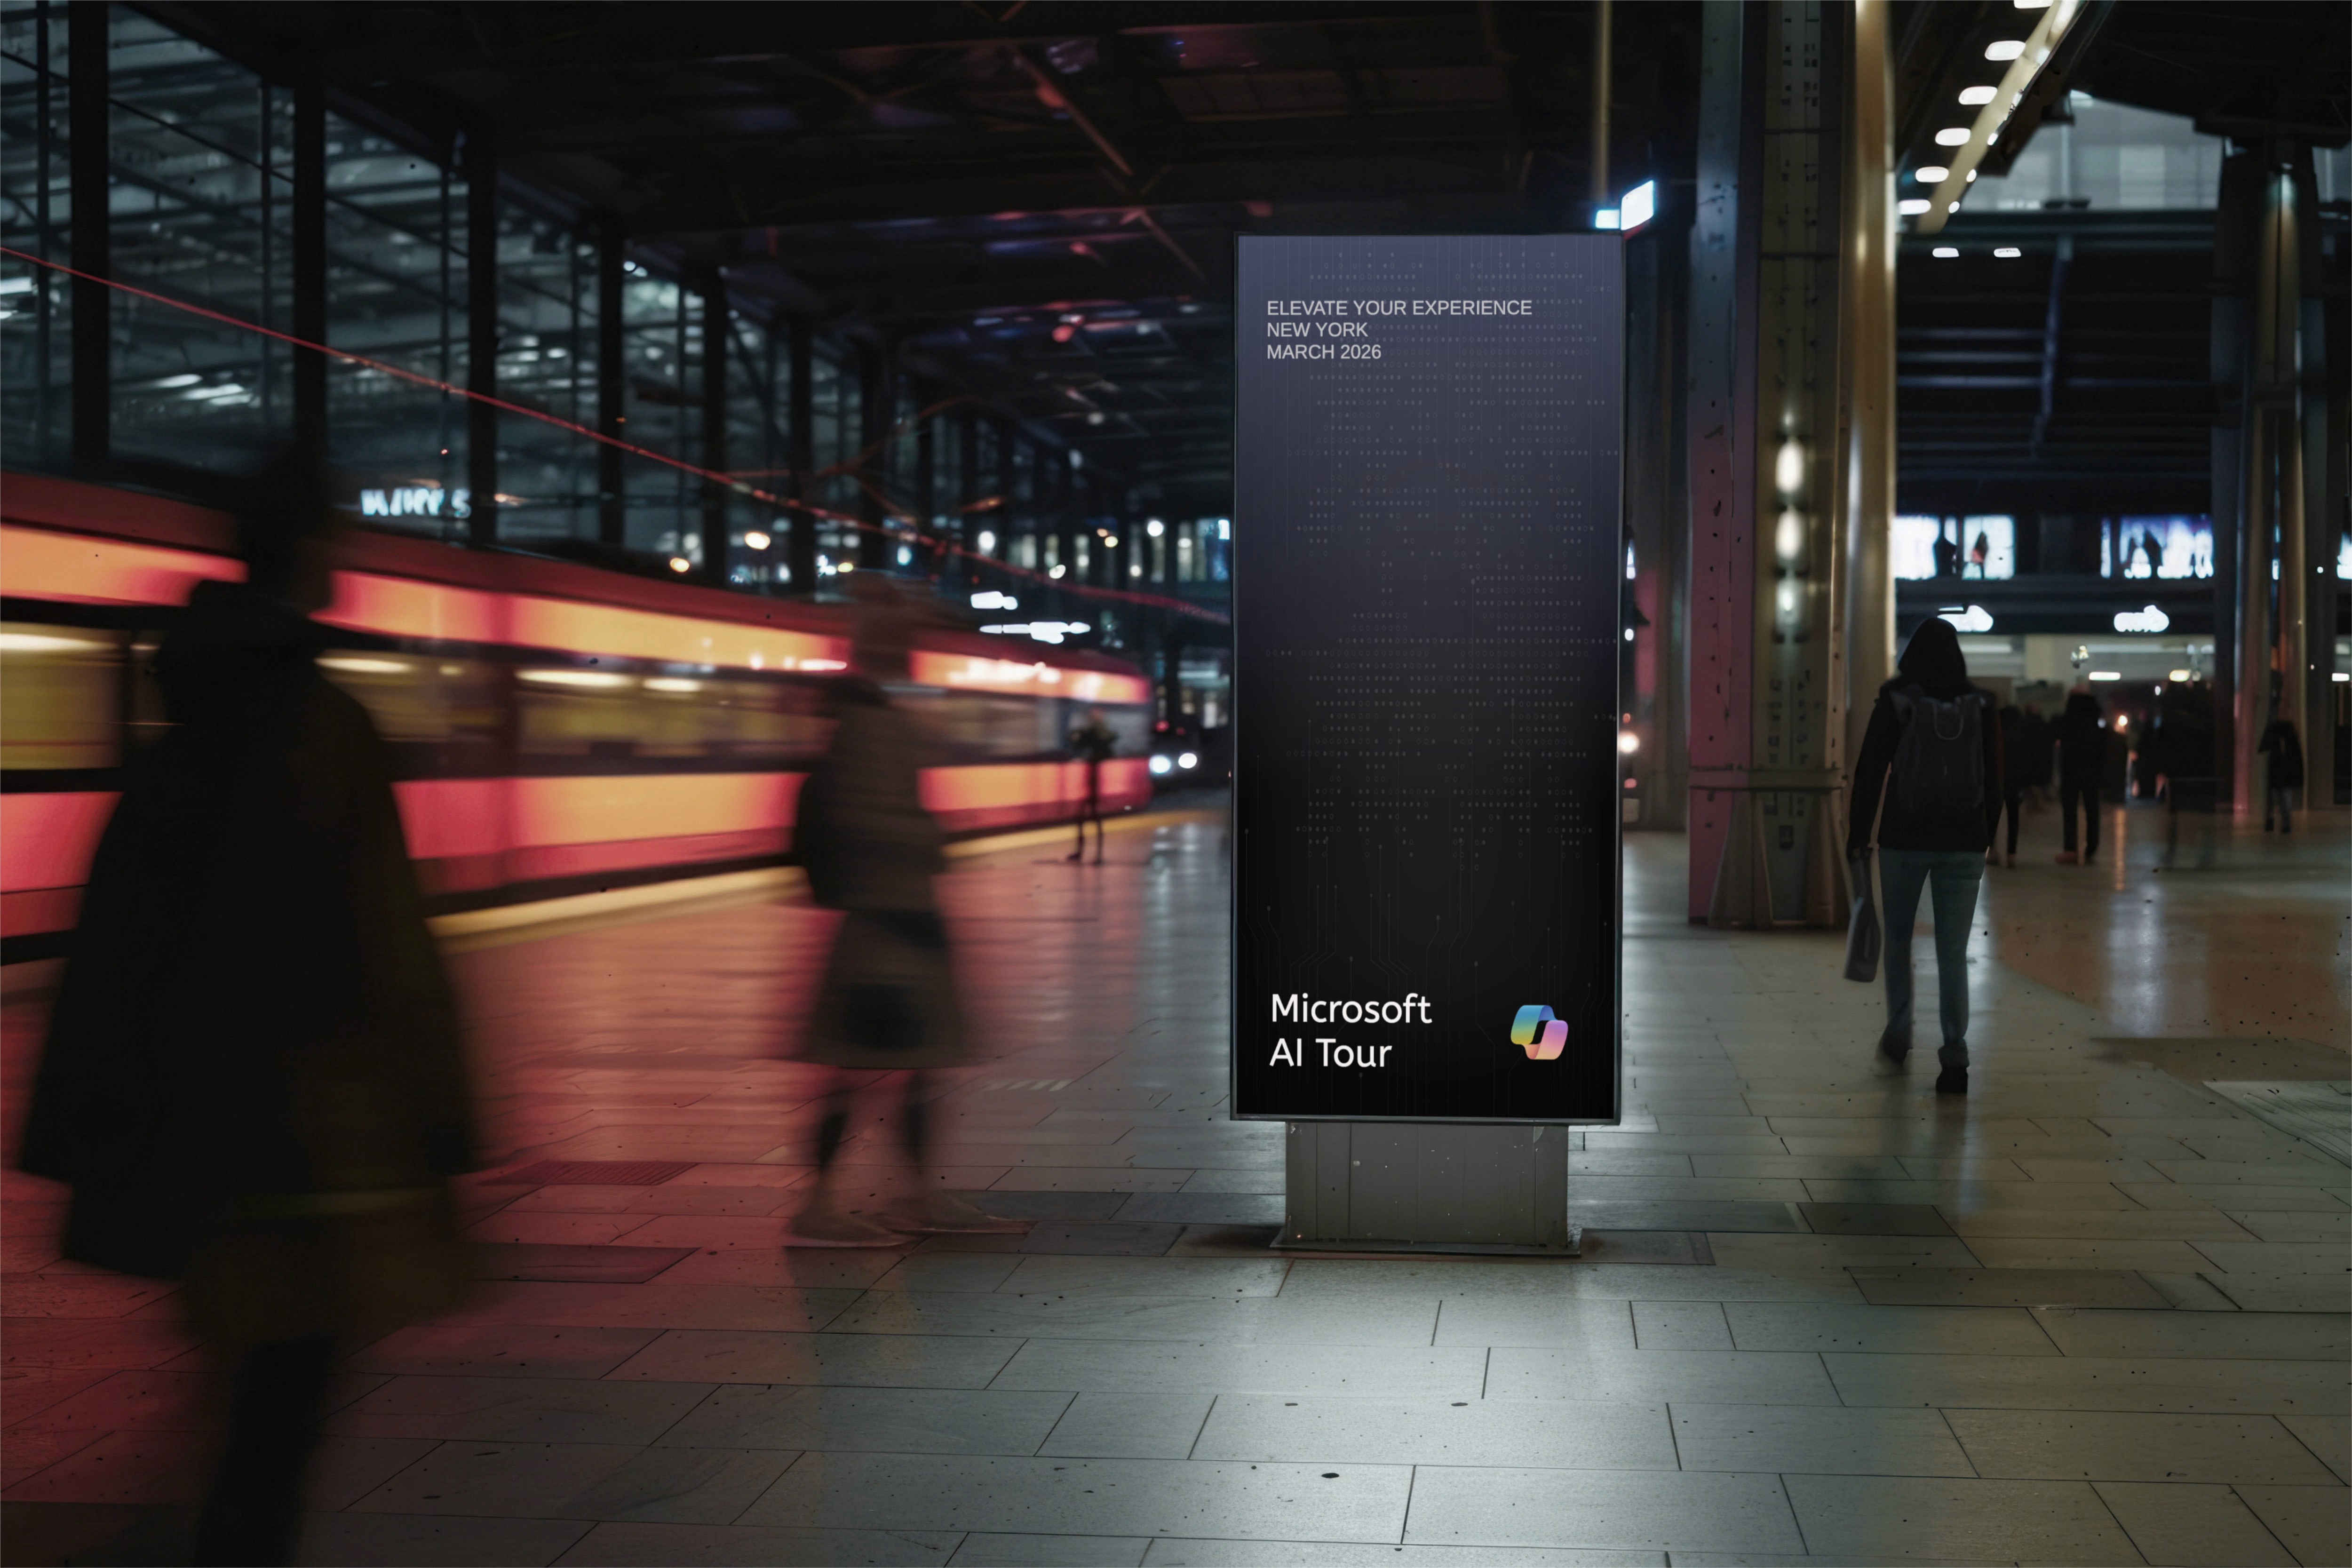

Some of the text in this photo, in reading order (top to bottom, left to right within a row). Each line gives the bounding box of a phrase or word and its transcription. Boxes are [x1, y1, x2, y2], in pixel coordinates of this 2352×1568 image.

[1267, 300, 1533, 316] ELEVATE YOUR EXPERIENCE
[1267, 322, 1368, 337] NEW YORK
[1267, 344, 1382, 359] MARCH 2026
[1271, 993, 1432, 1024] Microsoft
[1269, 1038, 1392, 1067] AI Tour
